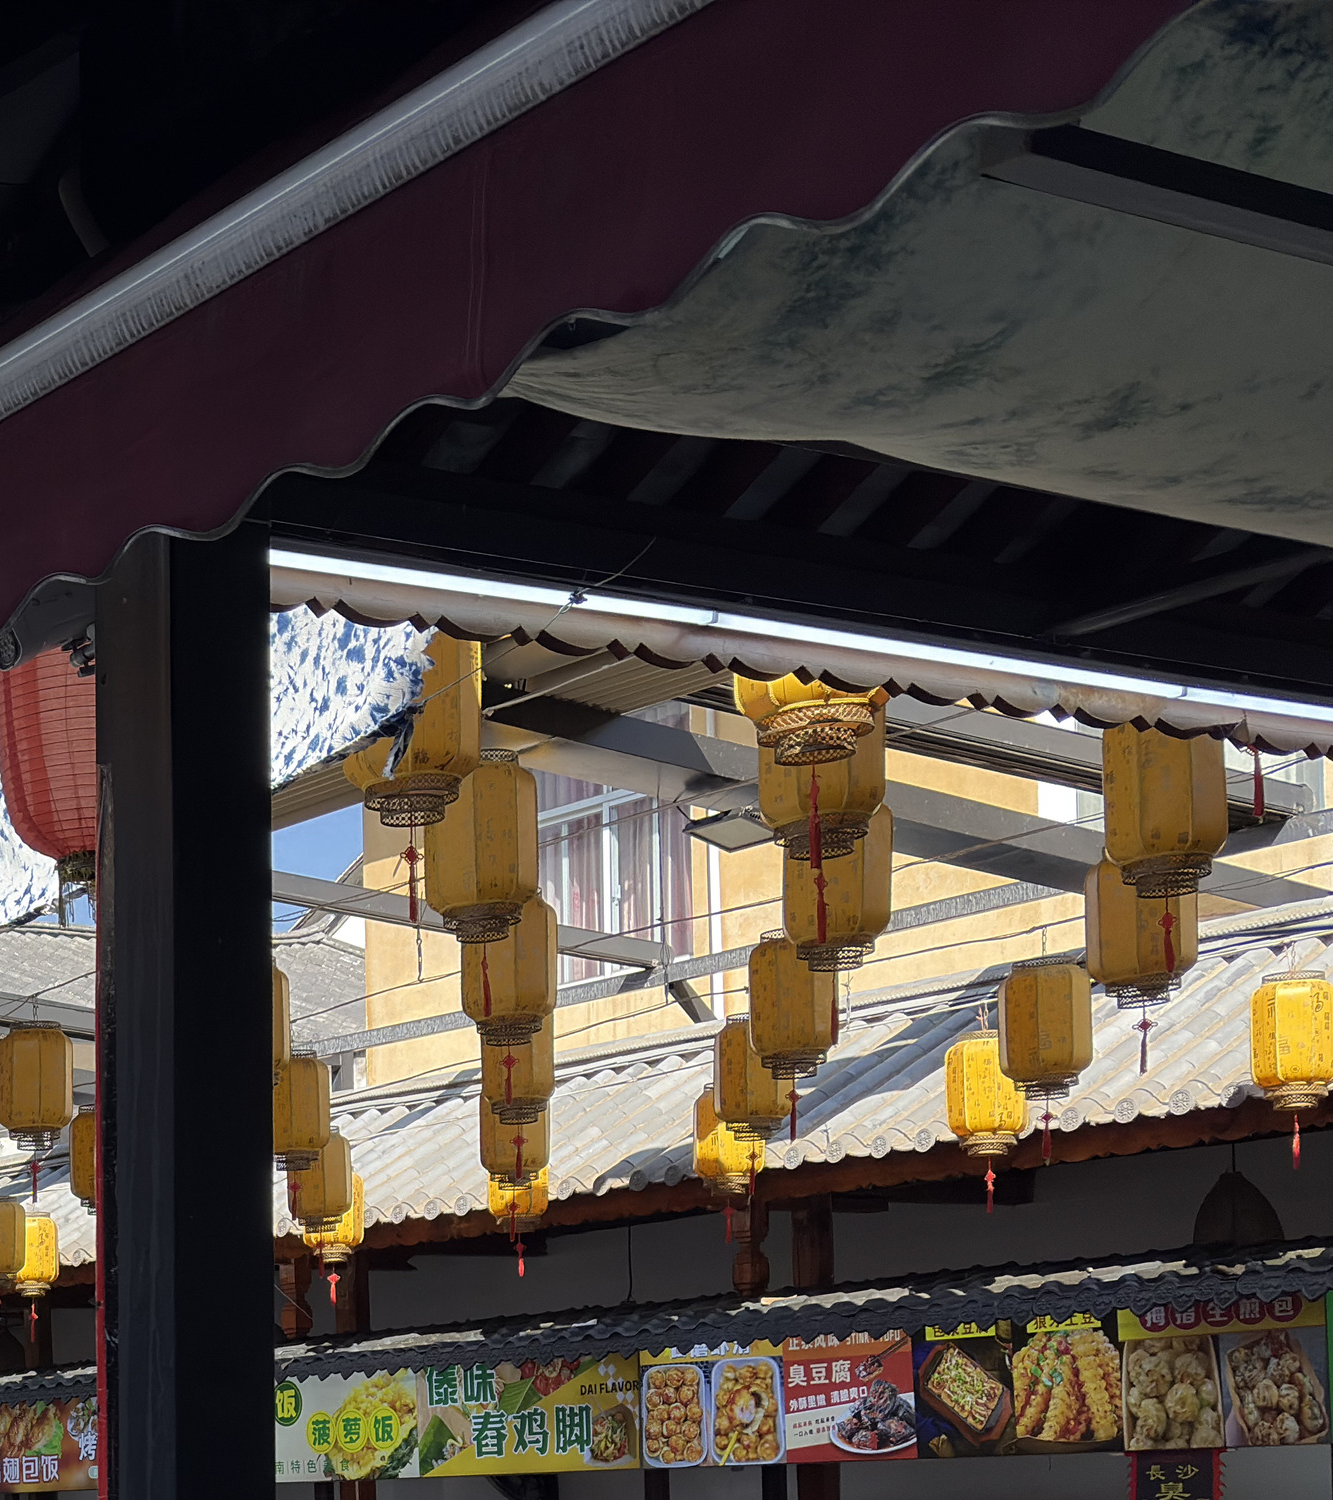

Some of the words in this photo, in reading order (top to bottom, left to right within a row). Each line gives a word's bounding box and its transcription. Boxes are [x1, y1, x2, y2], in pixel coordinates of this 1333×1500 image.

[846, 1331, 875, 1346] STINK
[426, 1363, 497, 1407] 傣味
[788, 1360, 851, 1387] 臭豆腐
[580, 1383, 598, 1396] DAI
[599, 1380, 639, 1395] FLAVOR
[275, 1389, 297, 1419] 饭
[312, 1415, 394, 1447] 菠萝饭
